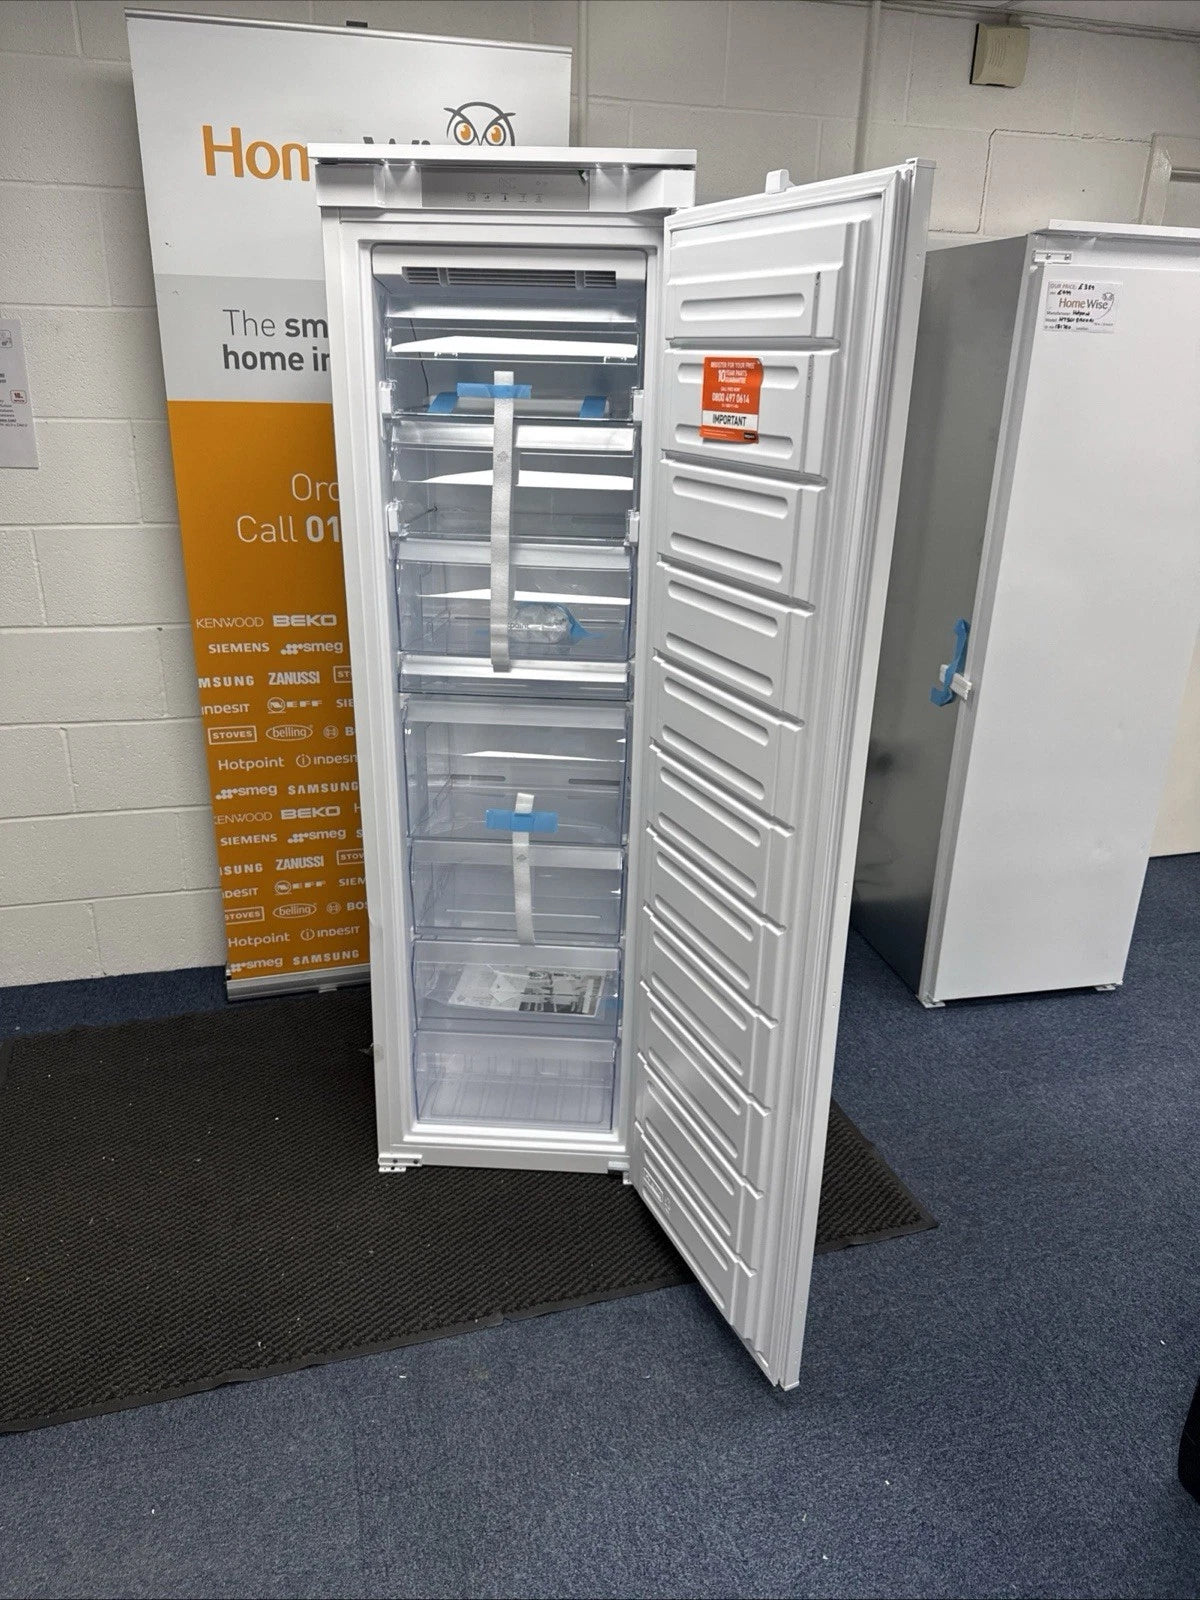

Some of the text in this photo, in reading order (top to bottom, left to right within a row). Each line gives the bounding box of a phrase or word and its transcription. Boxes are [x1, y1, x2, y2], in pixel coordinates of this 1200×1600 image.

[222, 310, 276, 336] The
[222, 344, 304, 371] home
[713, 414, 747, 426] IMPORTANT
[237, 515, 340, 542] Call 01
[196, 614, 337, 628] KENWOOD BEKO
[208, 642, 343, 654] SIEMENS smeg
[268, 670, 320, 686] ZANUSSI
[212, 730, 252, 740] STOVES
[272, 726, 307, 738] belling
[218, 756, 284, 771] Hotpoint
[238, 781, 358, 796] smeg SAMSUNG
[281, 806, 341, 820] BEKO
[220, 834, 278, 846] SIEMENS
[309, 829, 346, 841] smeg
[220, 863, 263, 876] SUNG
[276, 855, 324, 871] ZANUSSI
[279, 905, 311, 916] belling
[228, 933, 290, 948] Hotpoint
[246, 950, 359, 969] smeg SAMSUNG
